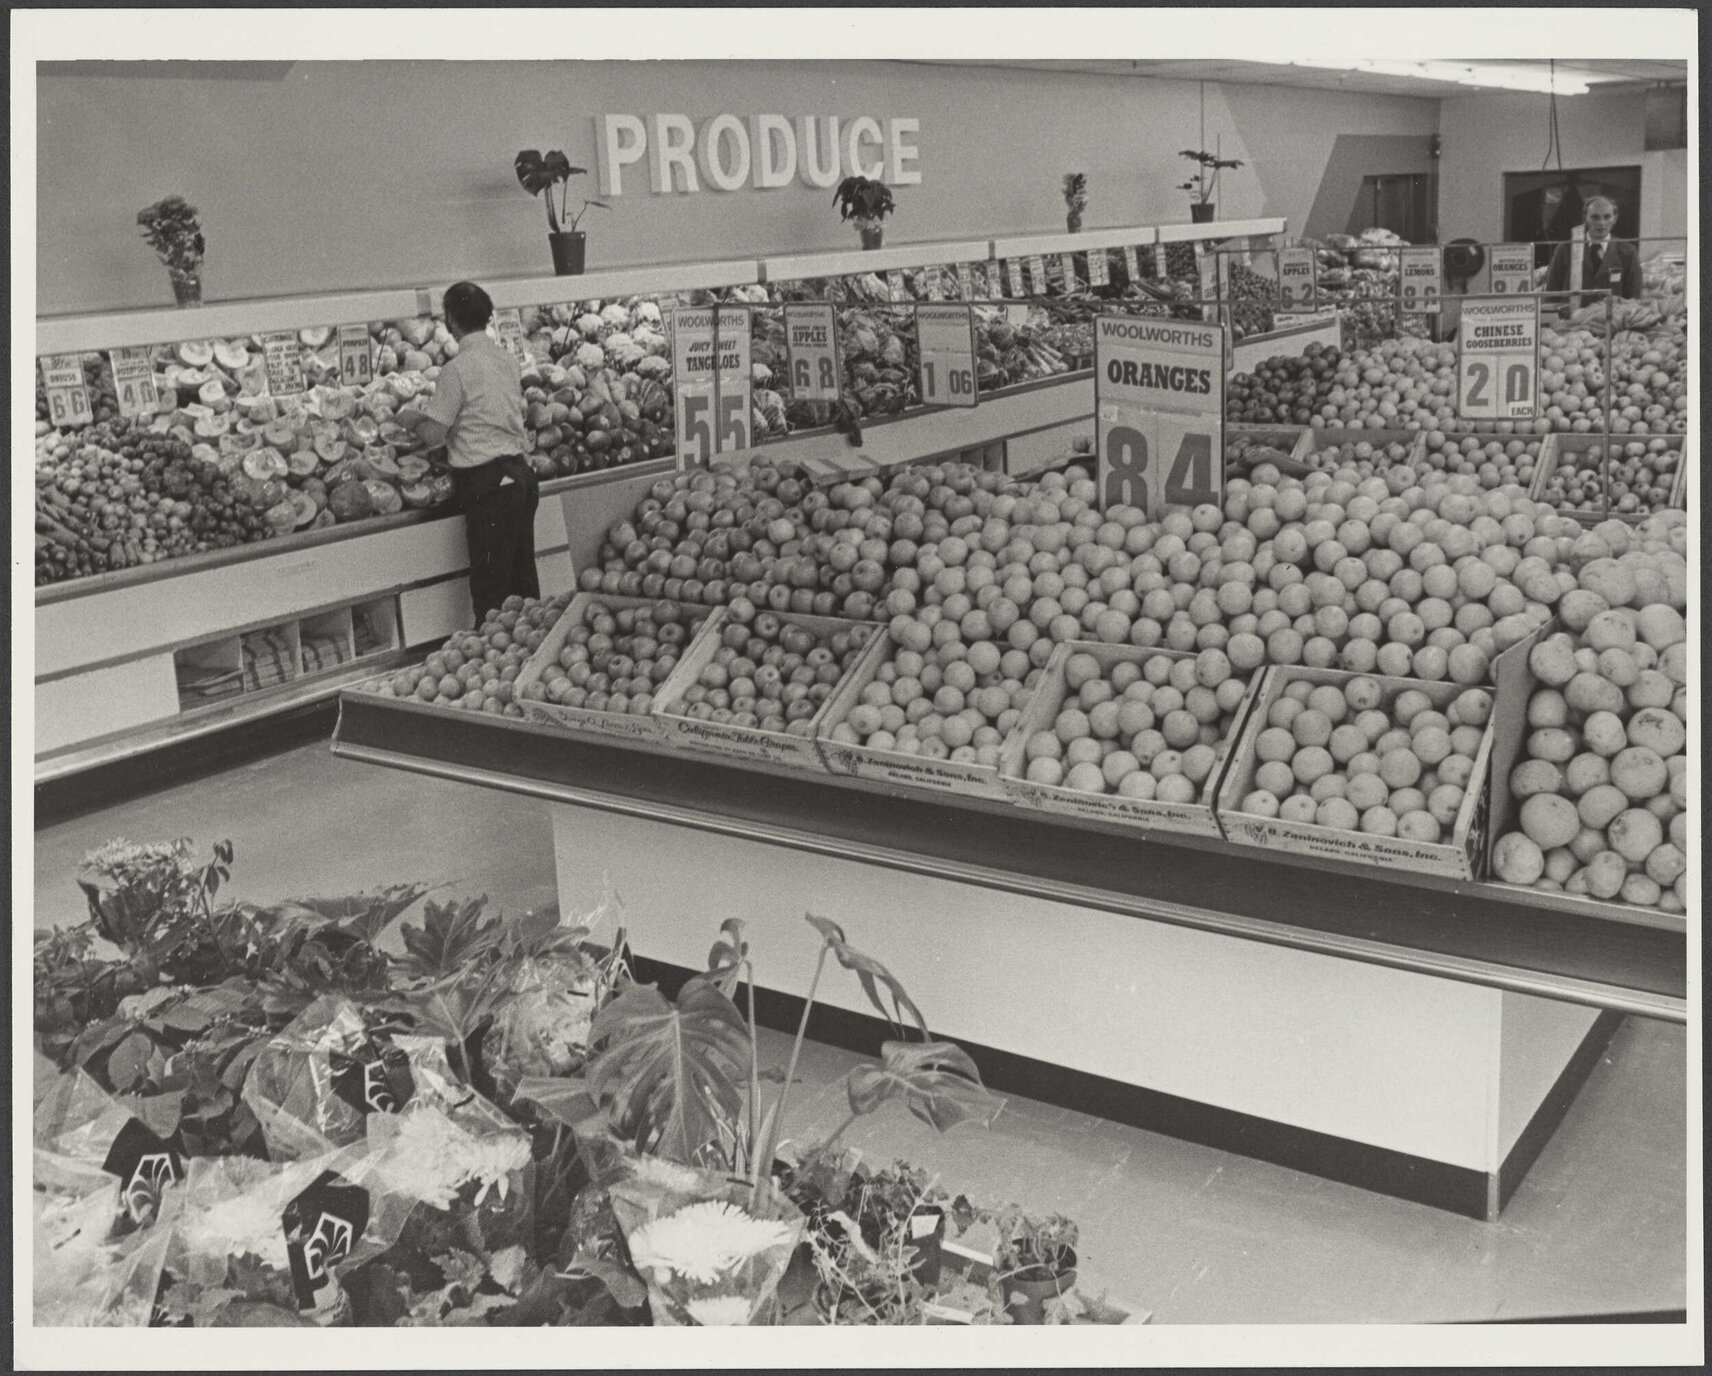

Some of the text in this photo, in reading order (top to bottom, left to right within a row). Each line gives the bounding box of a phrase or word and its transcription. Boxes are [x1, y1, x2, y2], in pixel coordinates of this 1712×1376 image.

[598, 113, 922, 196] PRODUCE
[1404, 268, 1435, 277] LEMONS
[1493, 263, 1528, 272] ORANGES
[1463, 304, 1536, 316] WOOLWORTHS
[678, 315, 745, 328] WOOLWRTHS
[792, 332, 827, 342] APPLES
[1101, 322, 1213, 348] WOOLWORTHS
[1474, 325, 1523, 338] CHINESE
[688, 341, 711, 353] JUICY
[1466, 338, 1532, 349] GOOSEBERRIES
[949, 369, 973, 395] 06
[1107, 359, 1211, 395] ORANGES
[1511, 406, 1533, 417] EACH
[1282, 830, 1356, 849] Zaninovich
[1358, 842, 1372, 851] &
